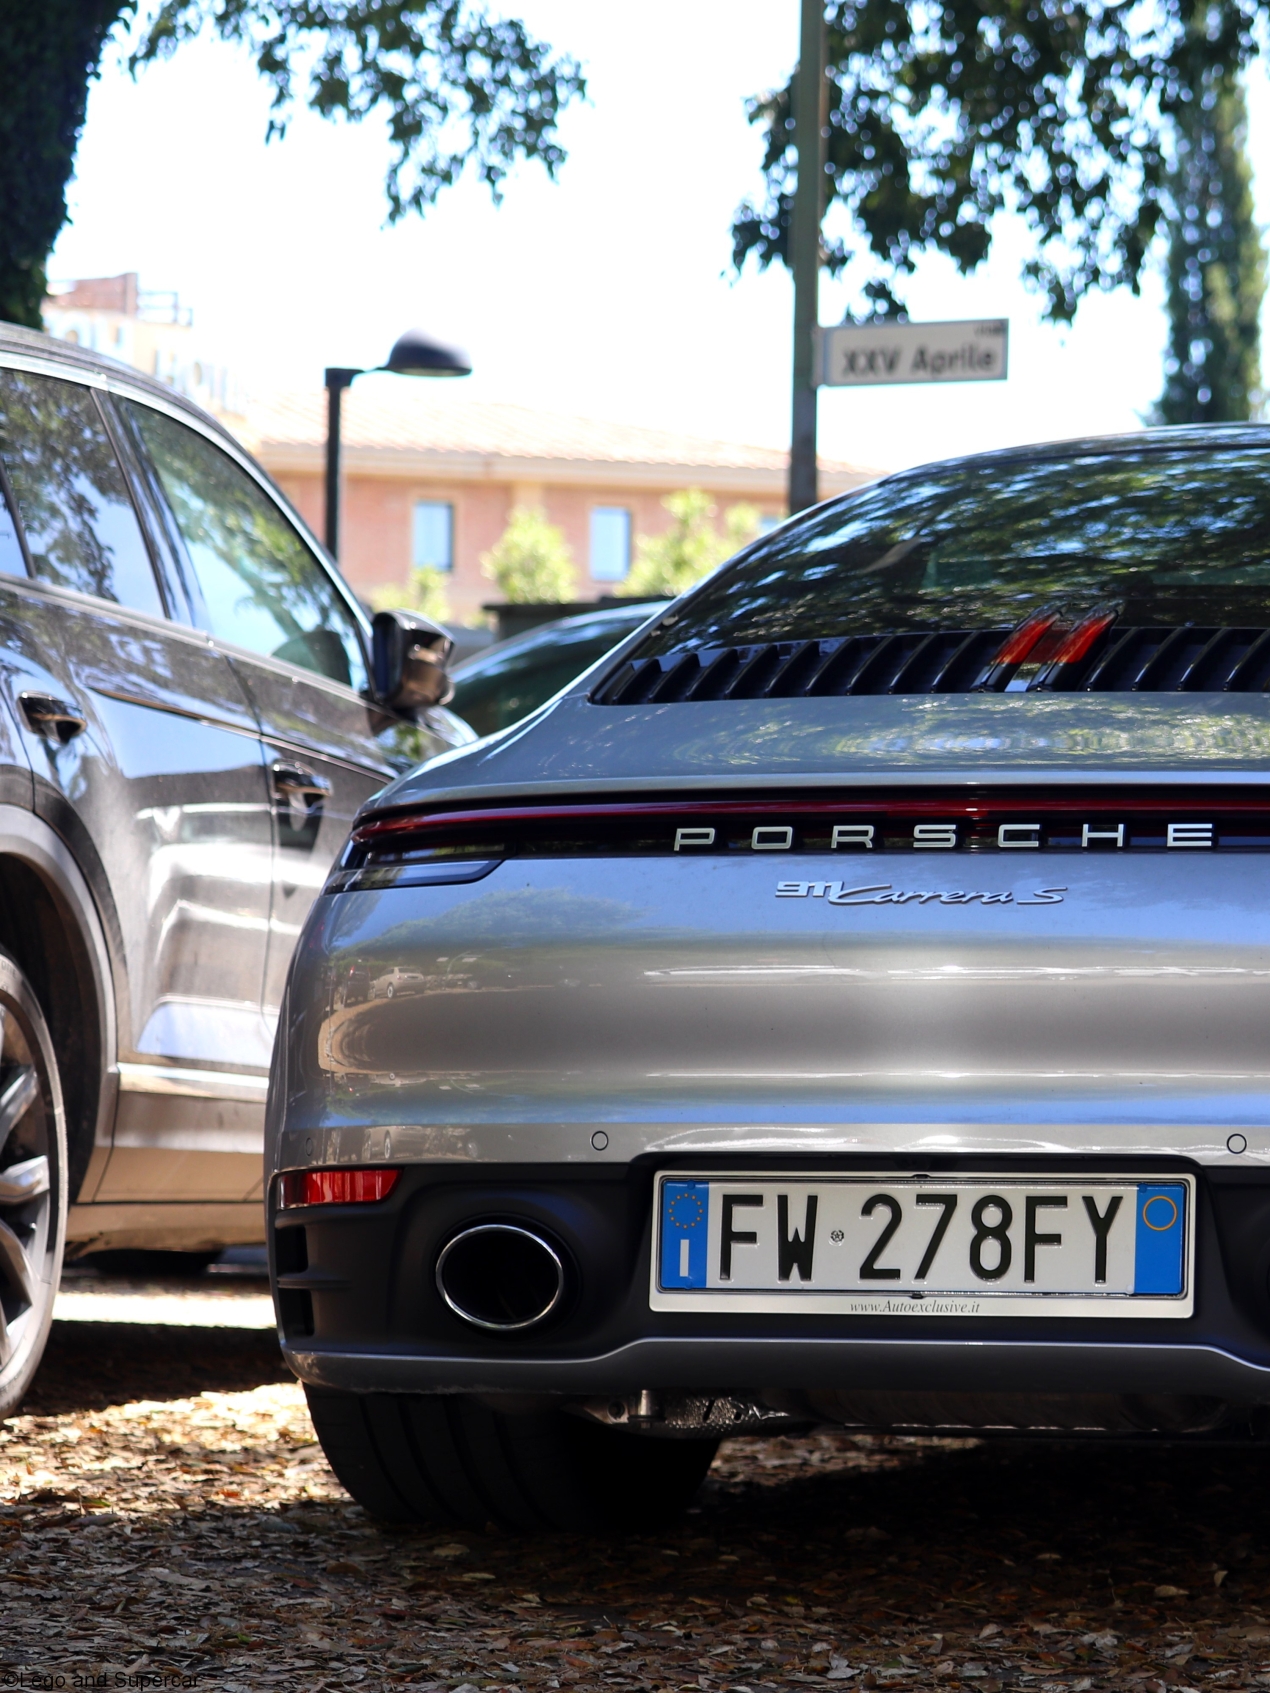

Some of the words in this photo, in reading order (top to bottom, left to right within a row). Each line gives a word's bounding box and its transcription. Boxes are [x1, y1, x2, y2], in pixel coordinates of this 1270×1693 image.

[842, 346, 902, 378] XXV
[909, 341, 996, 379] Aprile
[673, 823, 1213, 852] PORSCHE
[775, 880, 844, 898] 911
[827, 883, 1014, 905] Carrera
[1016, 886, 1068, 905] S
[718, 1193, 819, 1281] FW
[858, 1193, 1124, 1284] 278FY
[850, 1300, 981, 1314] www.Autoexclusive.it
